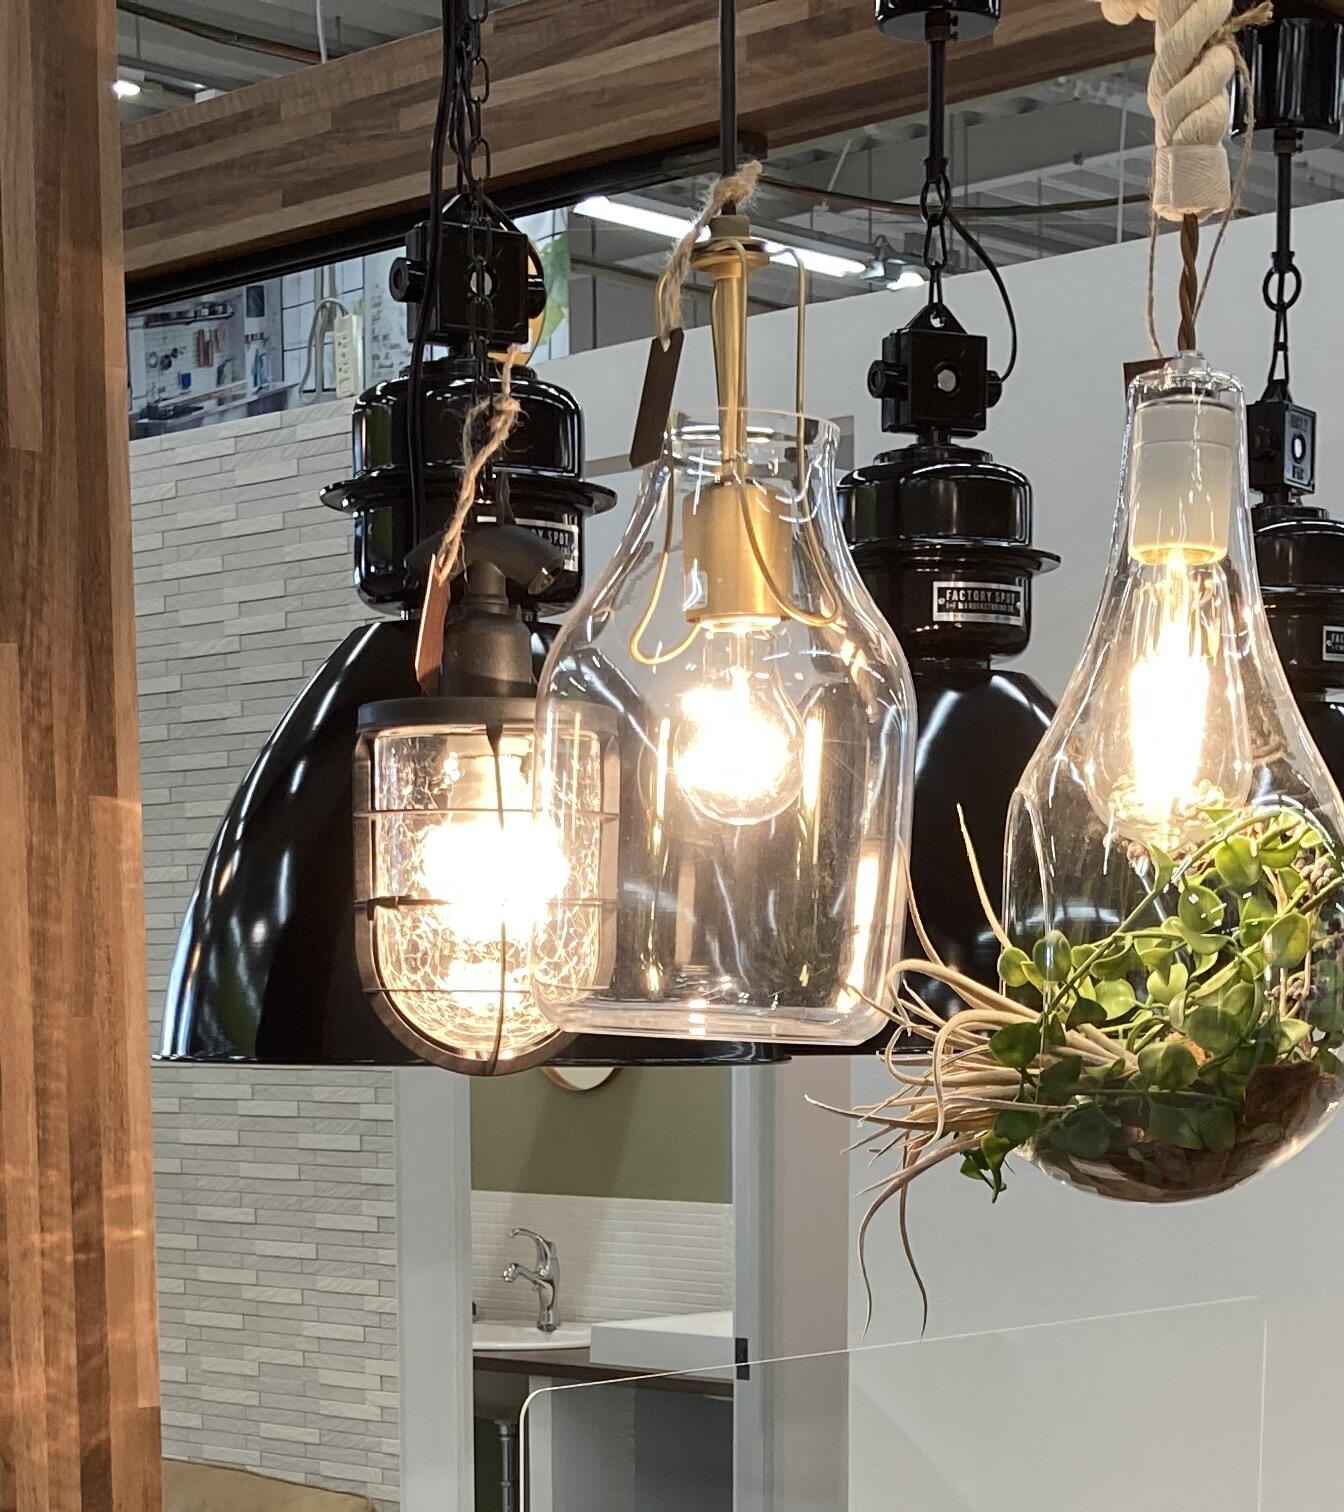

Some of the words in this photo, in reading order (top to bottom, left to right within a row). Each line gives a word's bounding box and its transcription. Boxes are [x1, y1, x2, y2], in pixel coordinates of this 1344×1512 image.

[548, 531, 569, 545] SPOT
[945, 589, 992, 603] FACTORY
[994, 591, 1016, 604] SPOT
